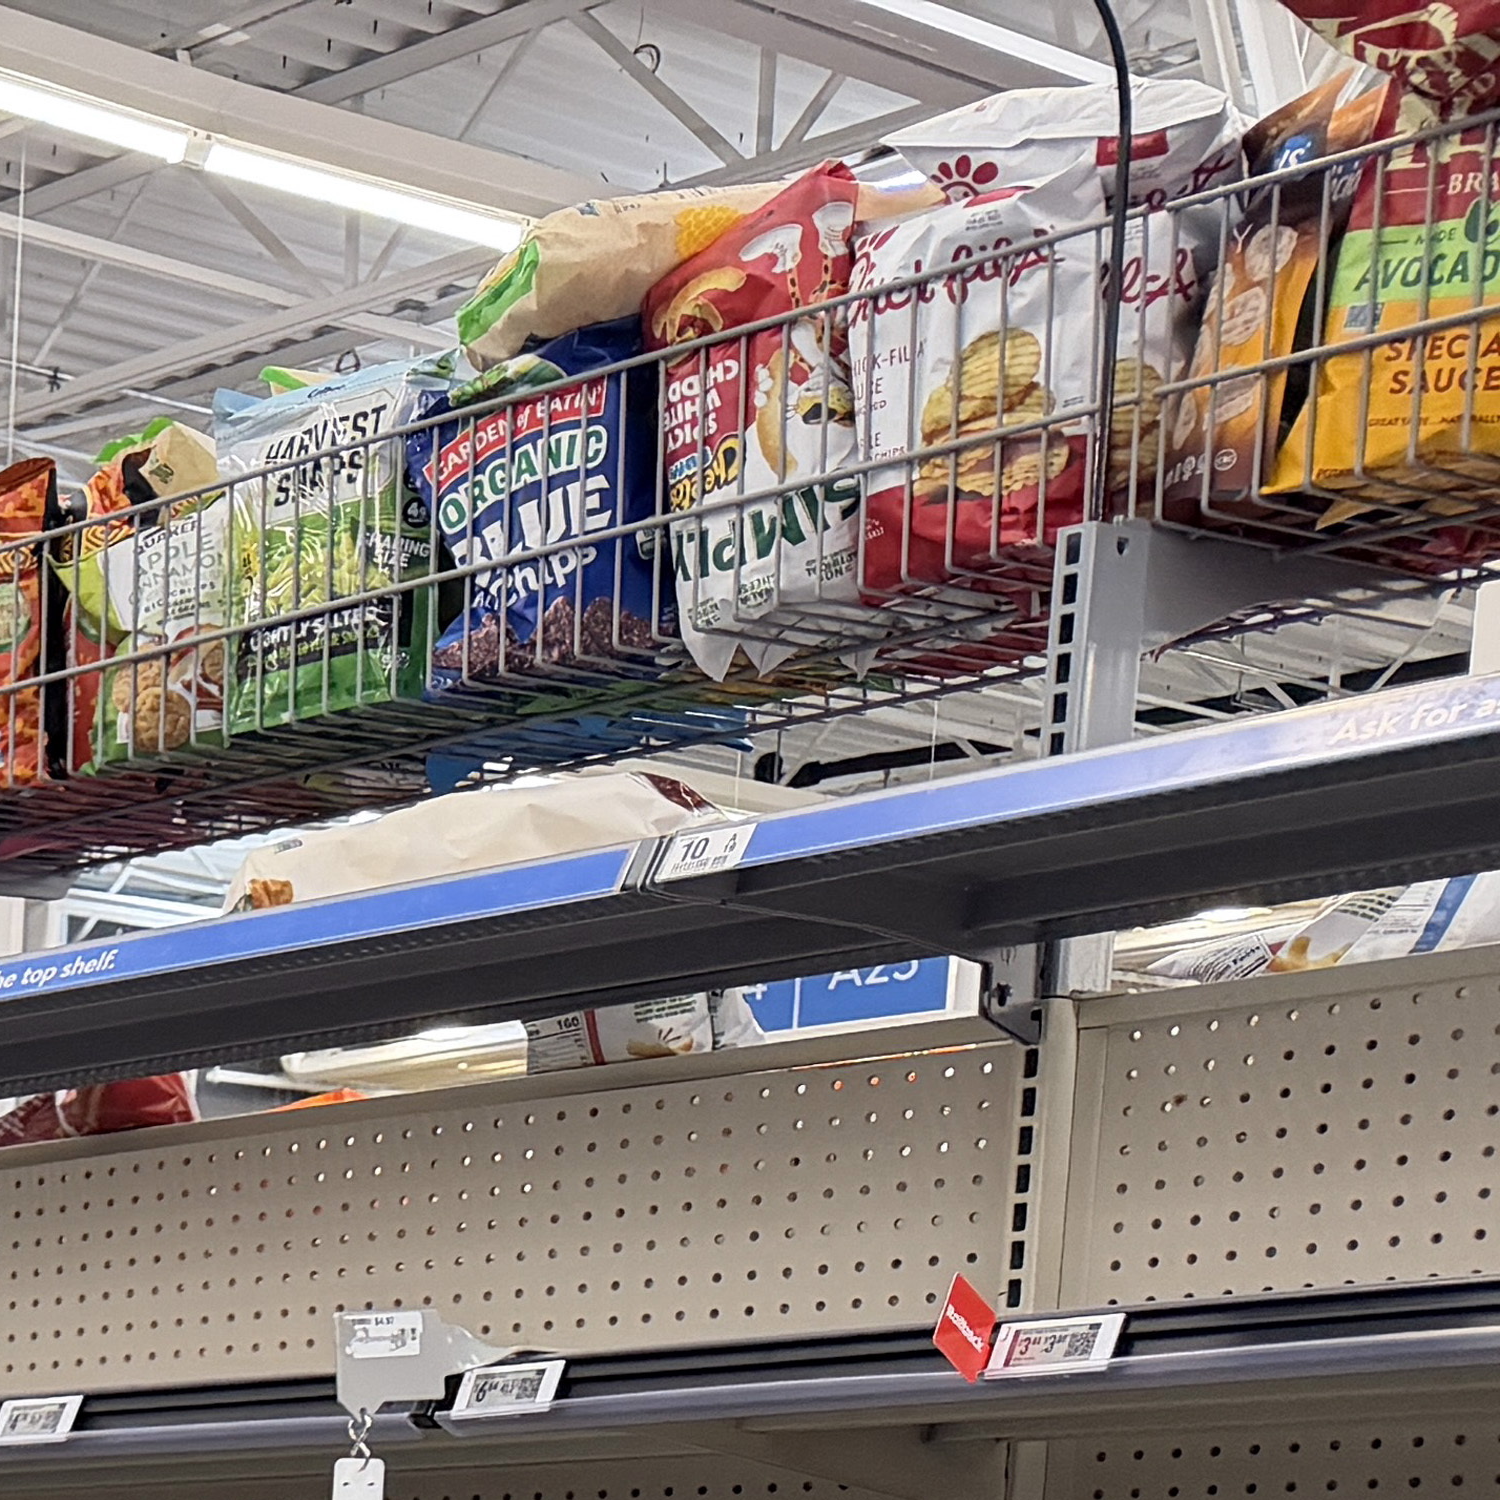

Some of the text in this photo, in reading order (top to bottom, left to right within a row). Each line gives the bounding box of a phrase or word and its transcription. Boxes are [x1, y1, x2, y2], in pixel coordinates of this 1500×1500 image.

[440, 429, 607, 532] ORGANIC
[1409, 702, 1468, 731] for
[681, 836, 710, 862] 10
[19, 967, 58, 988] top
